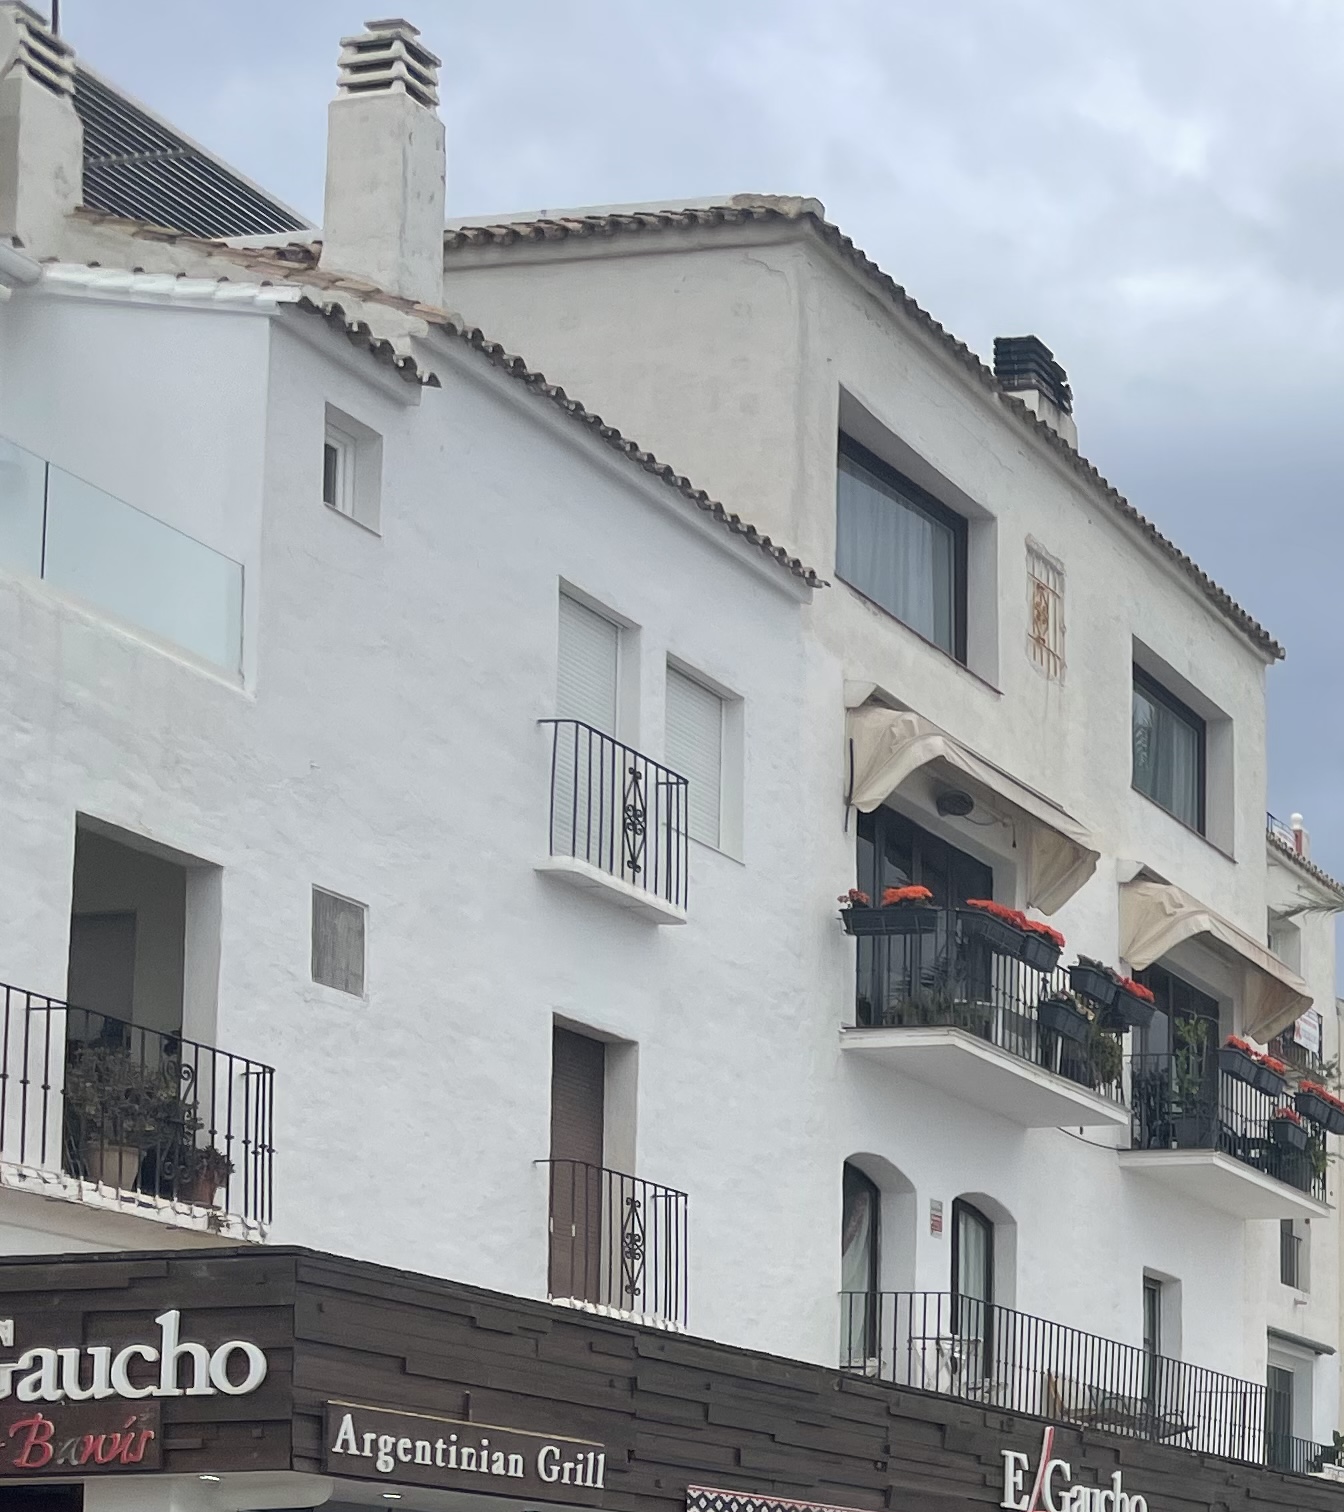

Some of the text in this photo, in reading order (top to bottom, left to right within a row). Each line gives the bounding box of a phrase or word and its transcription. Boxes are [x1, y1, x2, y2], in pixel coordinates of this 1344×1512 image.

[0, 1309, 268, 1402] aucho
[331, 1413, 606, 1489] Argentinian Grill
